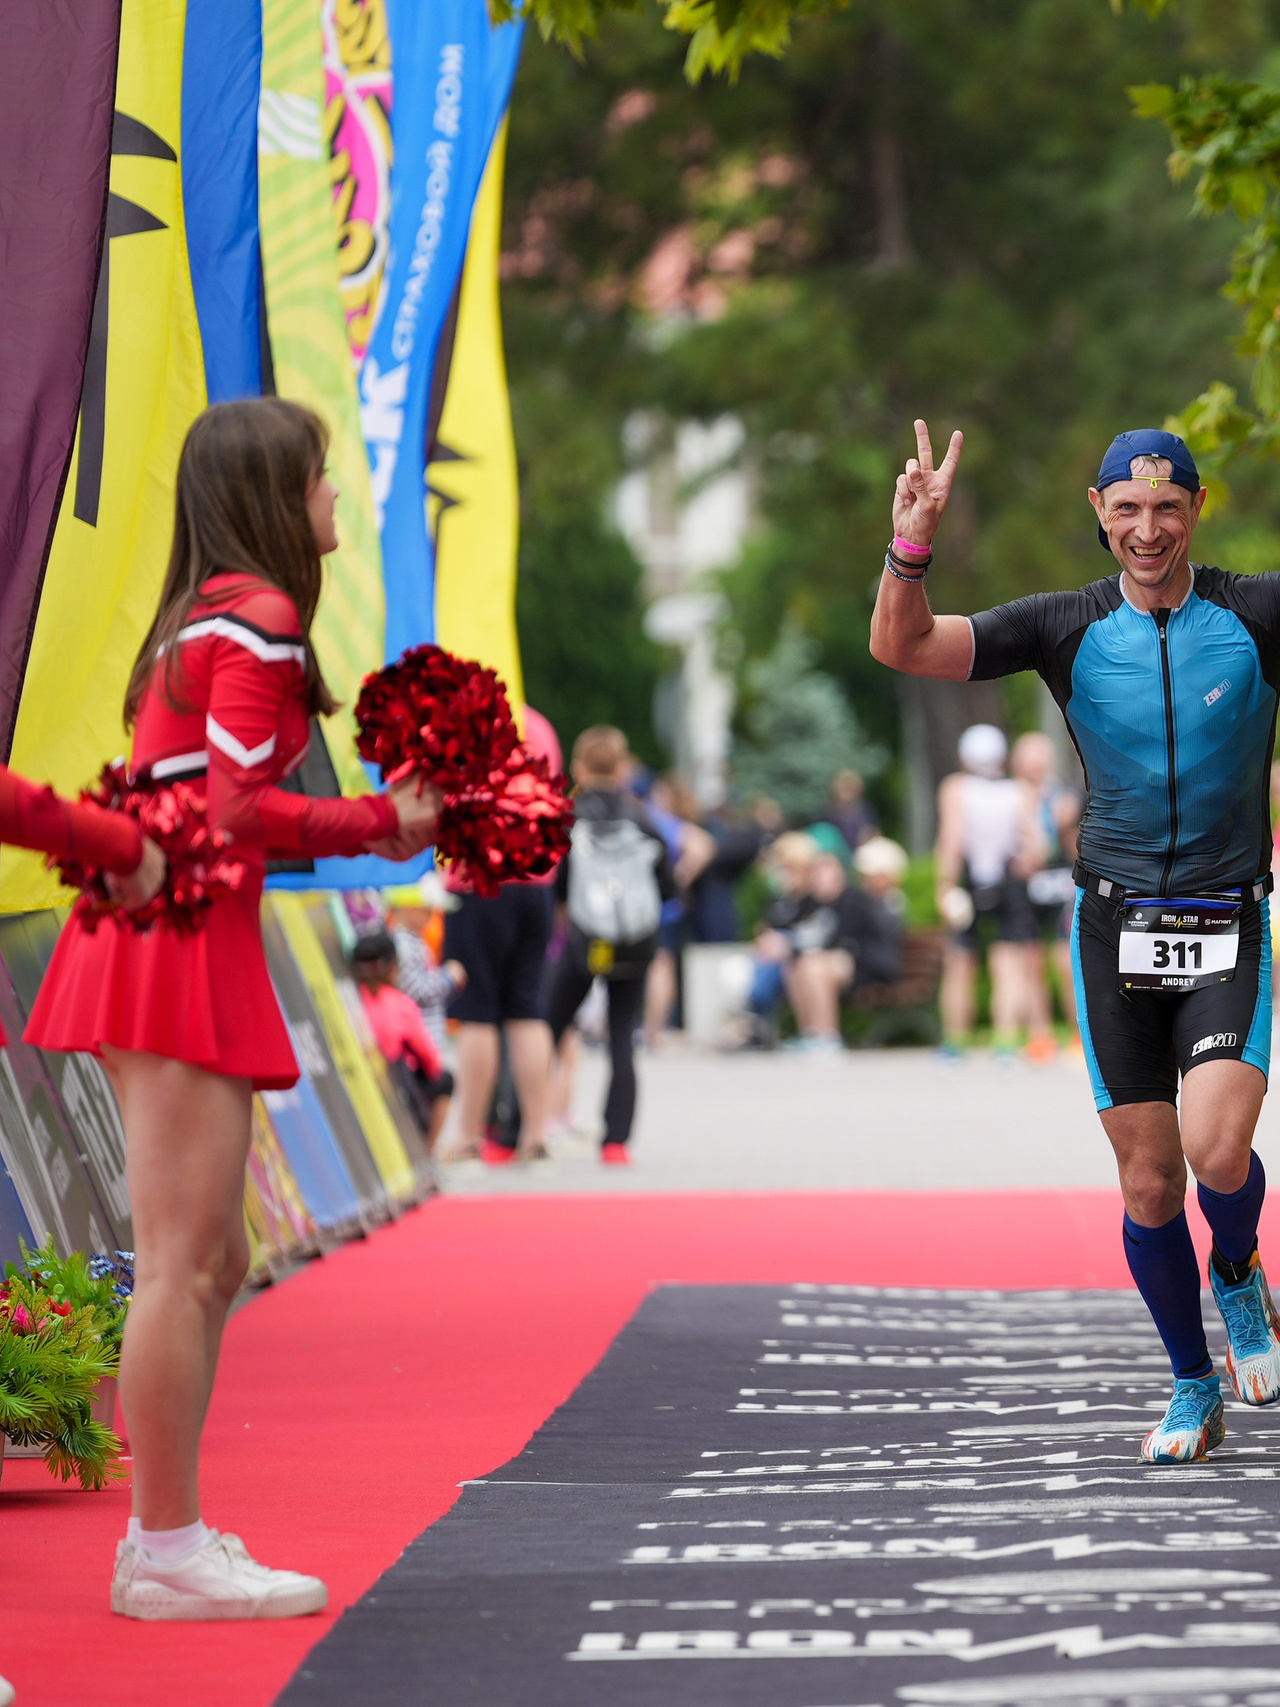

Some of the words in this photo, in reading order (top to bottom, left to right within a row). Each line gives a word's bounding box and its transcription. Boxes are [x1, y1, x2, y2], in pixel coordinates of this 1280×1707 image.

[433, 43, 465, 138] ДОМ
[1161, 914, 1177, 922] IRON
[1183, 915, 1199, 923] STAR
[1153, 940, 1202, 969] 311
[1161, 977, 1195, 986] ANDREY
[670, 1478, 976, 1496] IRON
[631, 1536, 977, 1560] IRON
[578, 1628, 974, 1652] IRON
